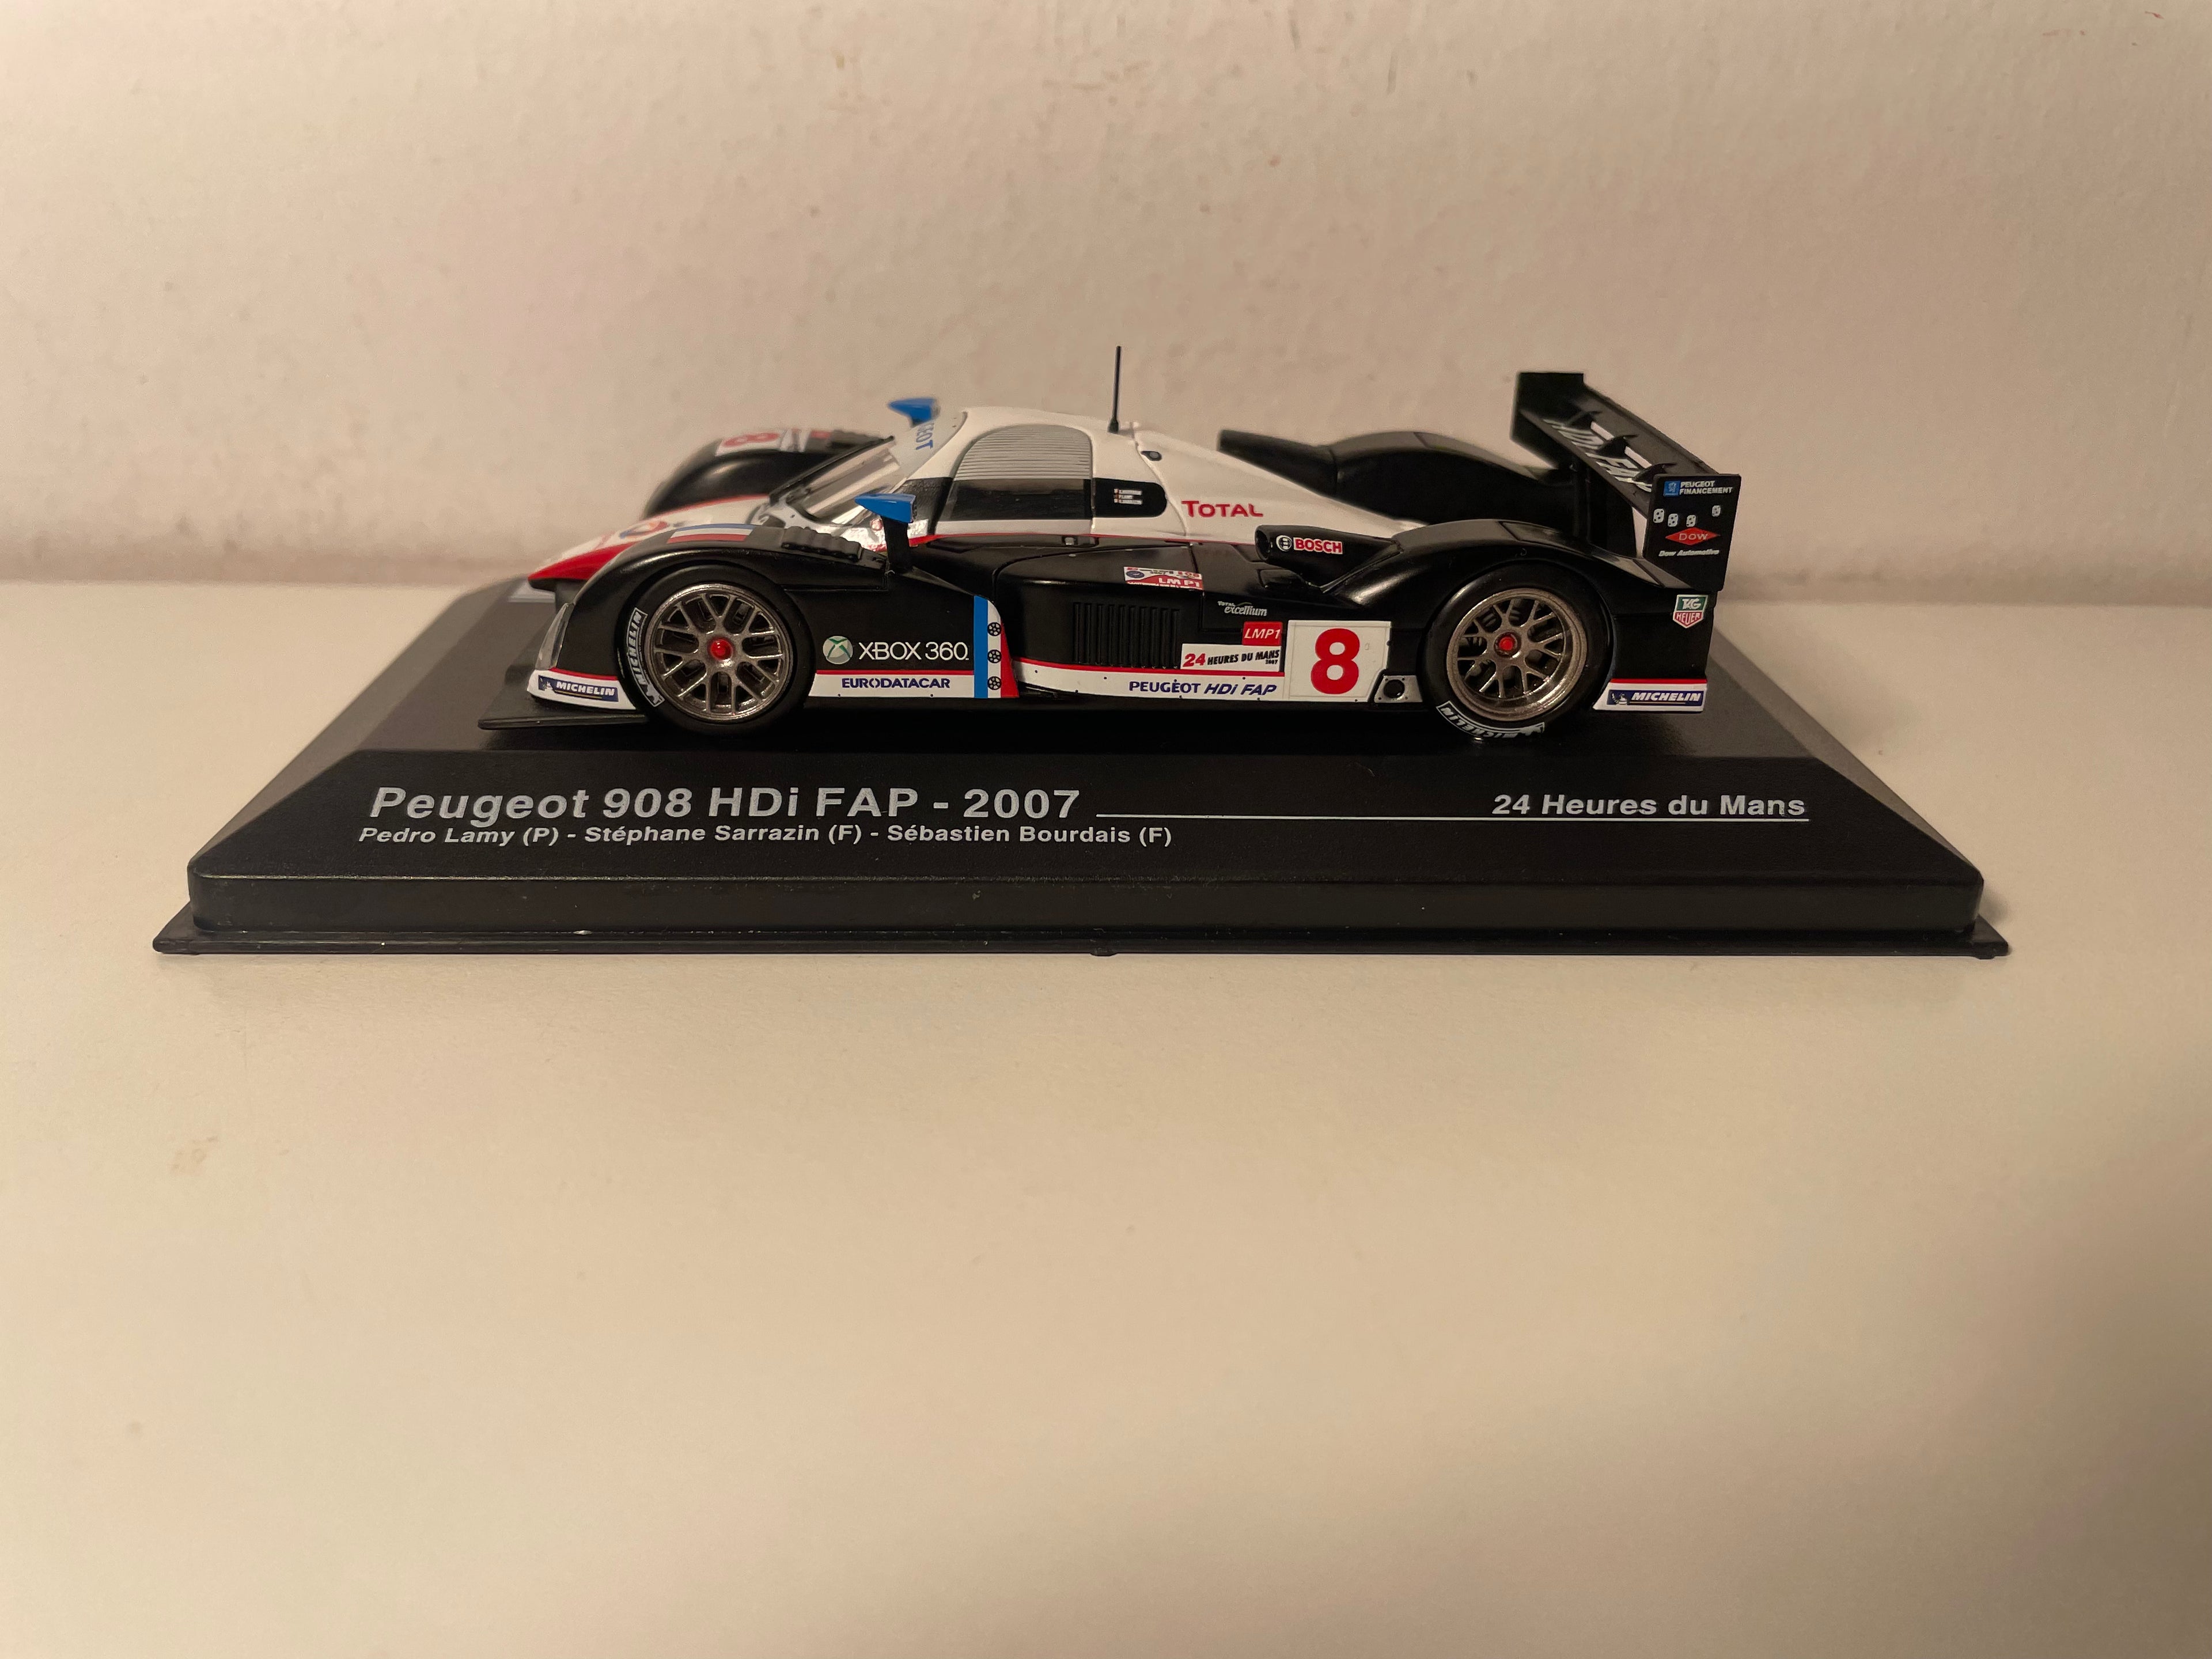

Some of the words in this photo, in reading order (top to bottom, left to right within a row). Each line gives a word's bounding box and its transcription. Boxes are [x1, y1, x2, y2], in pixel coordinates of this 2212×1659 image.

[1181, 501, 1263, 517] TOTAL
[1295, 539, 1342, 553] BOSCH
[1224, 605, 1267, 616] excellium
[1682, 598, 1701, 609] TAG
[1676, 612, 1700, 625] HEUER
[1244, 628, 1281, 639] LMP1
[628, 611, 646, 685] MICHELIN
[858, 642, 922, 660] XBOX
[1183, 653, 1206, 667] 24
[1207, 654, 1239, 665] HEURES
[1241, 653, 1253, 662] DU
[1255, 650, 1280, 661] MANS
[1310, 628, 1360, 695] 8
[556, 681, 615, 696] MICHELIN
[842, 678, 950, 688] EURODATACAR
[1129, 681, 1200, 693] PEUGEOT
[1204, 683, 1238, 695] HDi
[1240, 684, 1277, 695] FAP
[1631, 692, 1701, 702] MICHELIN
[1440, 707, 1518, 738] MICHELIN
[370, 786, 589, 828] Peugeot
[603, 787, 692, 818] 908
[709, 787, 798, 817] HDi
[816, 787, 918, 817] FAP
[964, 789, 1081, 819] 2007
[1491, 794, 1531, 815] 24
[1541, 794, 1657, 815] Heures
[1667, 795, 1708, 815] du
[1719, 795, 1805, 815] Mans
[358, 827, 436, 843] Pedro
[444, 828, 515, 847] Lamy
[523, 827, 559, 847] (P)
[585, 825, 706, 846] Stéphane
[714, 824, 819, 841] Sarrazin
[828, 824, 862, 844] (F)
[888, 824, 1011, 842] Sébastien
[1019, 825, 1131, 843] Bourdais
[1139, 826, 1172, 847] (F)
